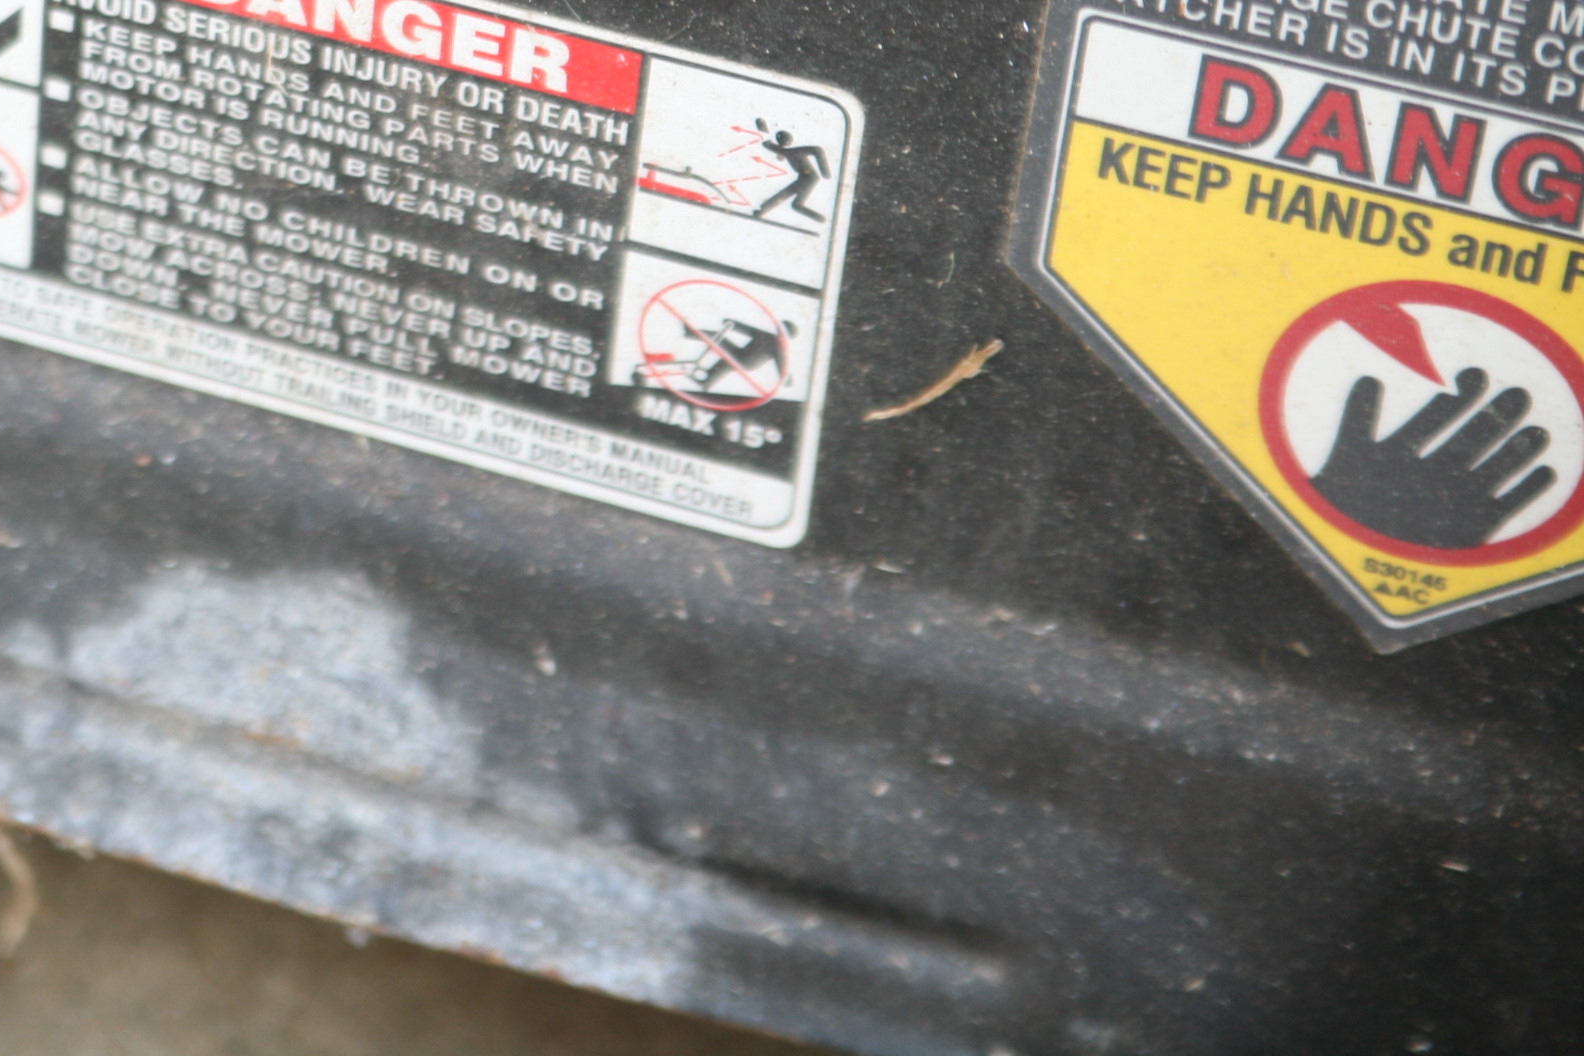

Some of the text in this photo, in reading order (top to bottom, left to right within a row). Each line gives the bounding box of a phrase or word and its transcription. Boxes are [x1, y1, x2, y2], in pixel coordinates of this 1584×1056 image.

[79, 60, 429, 167] MOTOR IS RUNNING.
[81, 39, 618, 194] FROM ROTATING PARTS WHEN
[82, 17, 618, 172] KEEP HANDS AND FEET AWAY
[165, 4, 312, 66] SERIOUS
[320, 44, 447, 100] INJURY
[457, 79, 505, 115] OR
[516, 94, 628, 147] DEATH
[1326, 22, 1369, 59] IS
[1389, 35, 1435, 75] IN
[1452, 50, 1527, 96] ITS
[71, 174, 398, 278] NEAR THE MOWER.
[74, 128, 243, 189] GLASSES.
[76, 107, 608, 263] ANY DIRECTION. WEAR SAFETY
[77, 86, 613, 242] OBJECTS CAN BE THROWN IN
[1098, 136, 1231, 204] KEEP
[1245, 173, 1433, 257] HANDS
[1447, 233, 1548, 286] and
[68, 220, 155, 261] MOW
[331, 291, 450, 340] NEVER
[460, 326, 510, 356] UP
[521, 342, 597, 379] AND
[69, 200, 136, 236] USE
[141, 219, 247, 265] EXTRA
[256, 250, 399, 305] CAUTION
[406, 290, 455, 321] ON
[73, 153, 604, 311] ALLOW NO CHILDREN ON OR
[65, 262, 180, 309] CLOSE
[188, 295, 236, 325] TO
[244, 310, 339, 352] YOUR
[212, 280, 332, 329] NEVER
[345, 316, 439, 358] PULL
[450, 344, 591, 398] MOWER
[34, 285, 93, 317] SAFE
[103, 303, 237, 355] OPERATION
[244, 341, 382, 394] PRACTICES
[385, 379, 408, 401] IN
[414, 387, 481, 421] YOUR
[489, 408, 604, 455] OWNER'S
[608, 440, 713, 484] MANUAL
[72, 318, 153, 357] MOWER
[164, 343, 267, 387] WITHOUT
[269, 372, 377, 418] TRAILING
[383, 402, 468, 442] SHIELD
[474, 426, 524, 456] AND
[528, 441, 664, 495] DISCHARGE
[670, 480, 755, 520] COVER
[638, 394, 716, 436] MAX
